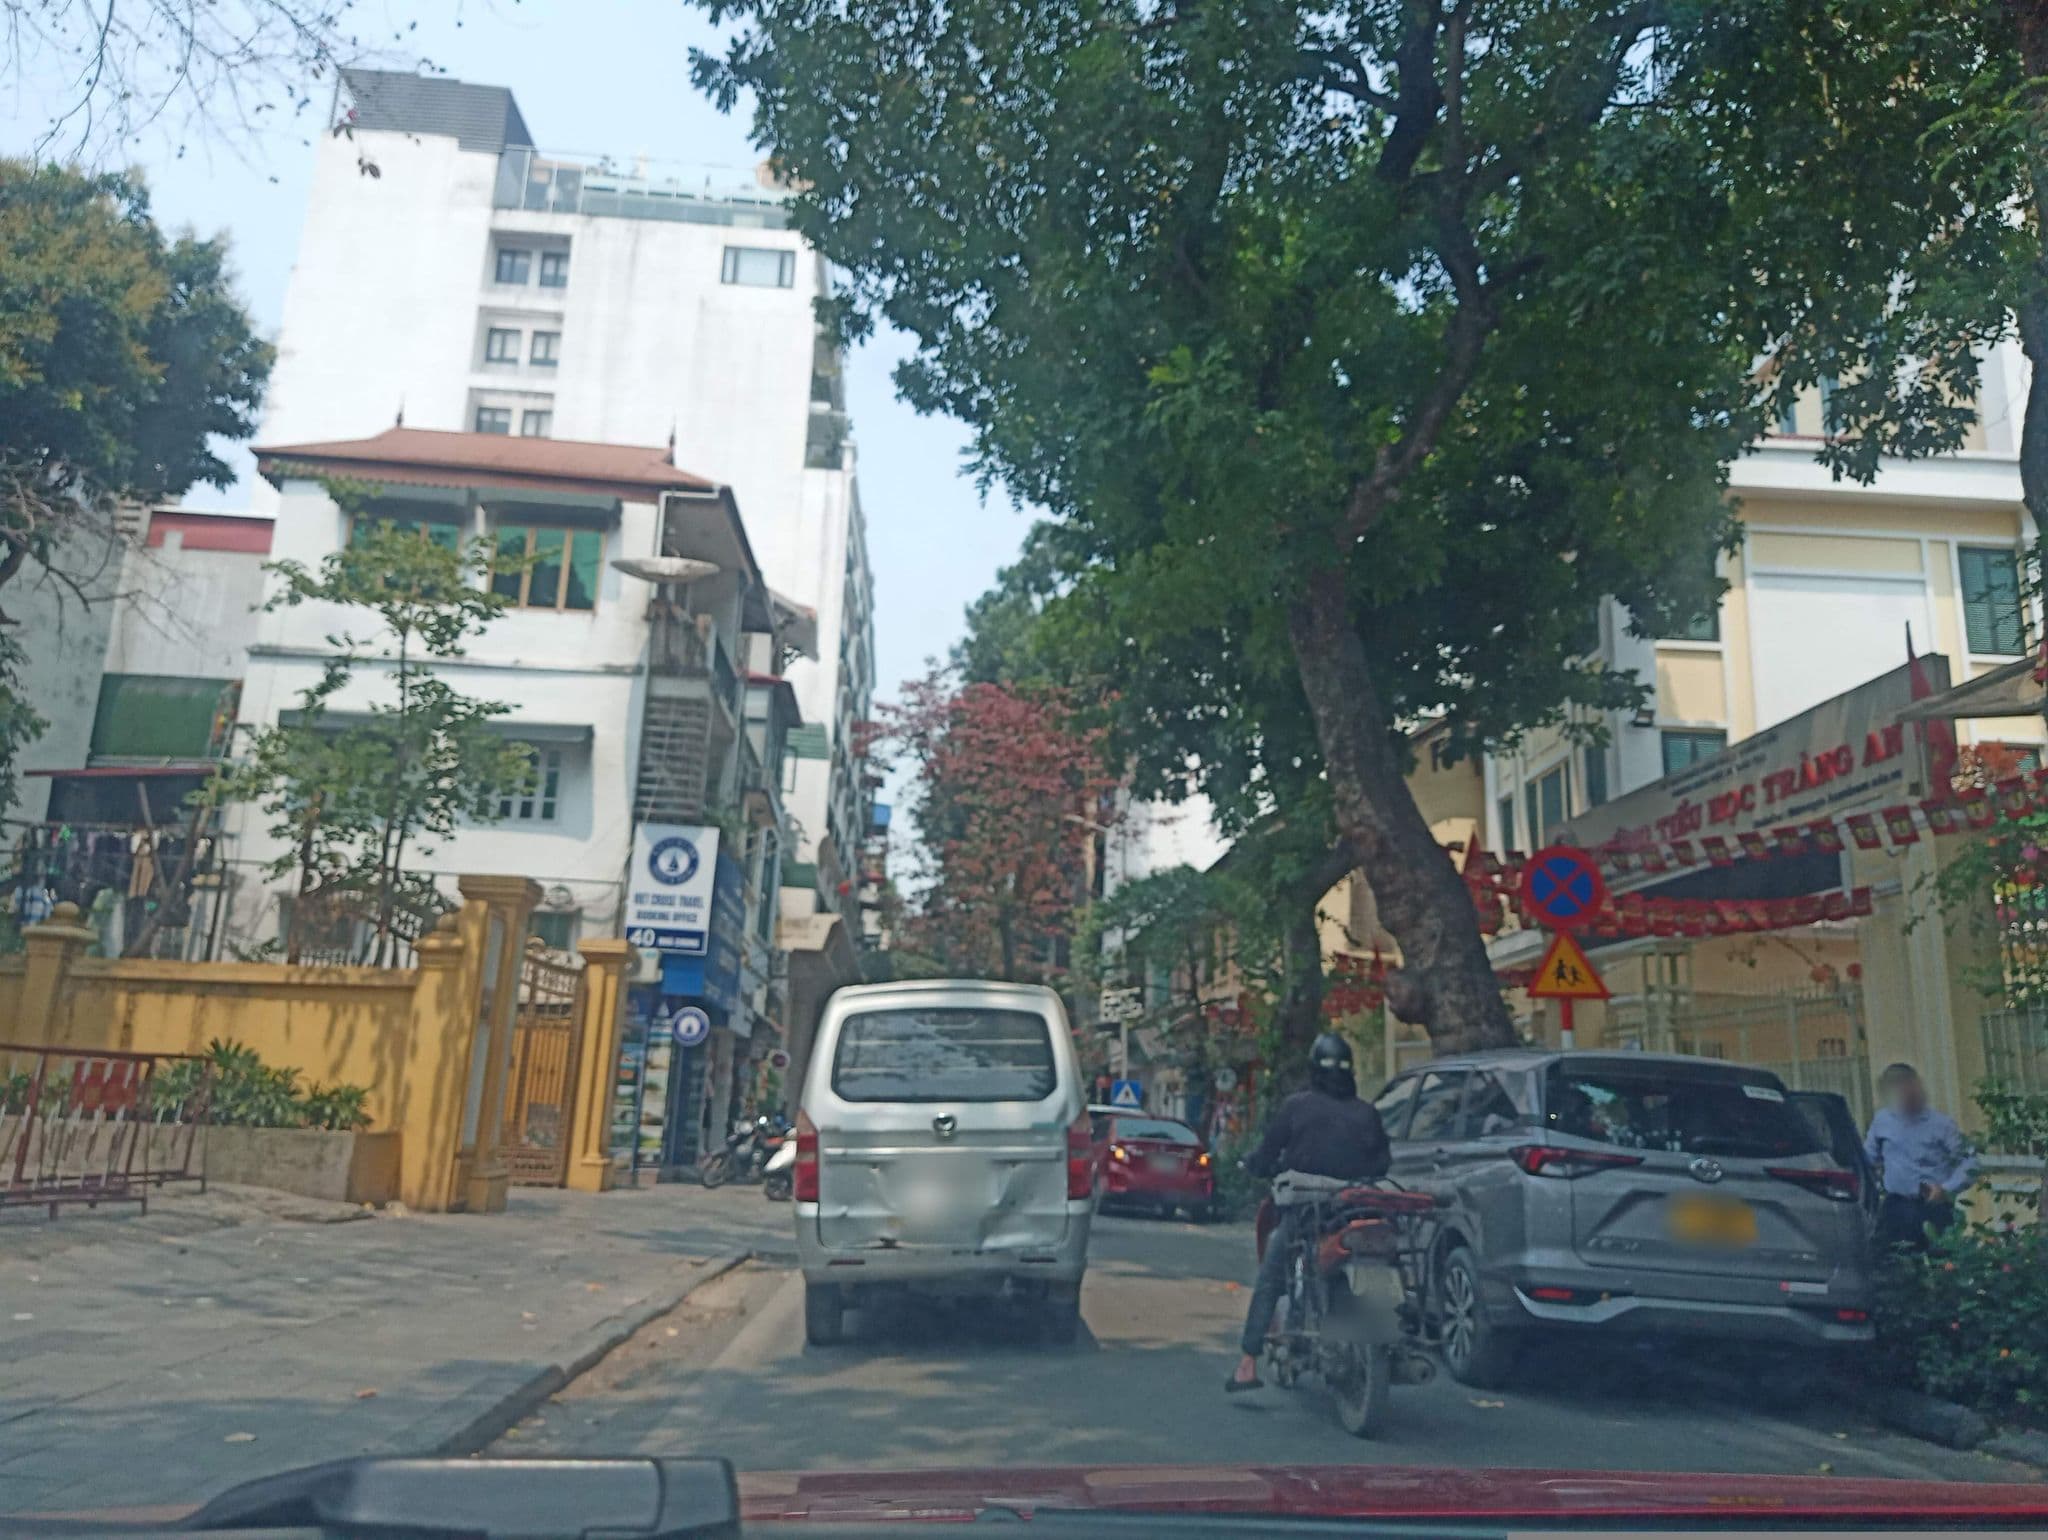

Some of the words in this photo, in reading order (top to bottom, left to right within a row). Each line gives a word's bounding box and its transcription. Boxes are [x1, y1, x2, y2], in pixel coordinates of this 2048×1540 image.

[1708, 783, 1756, 825] HỌC
[1762, 744, 1854, 804] TRÀNG
[1861, 722, 1904, 768] AN
[629, 928, 656, 947] 40
